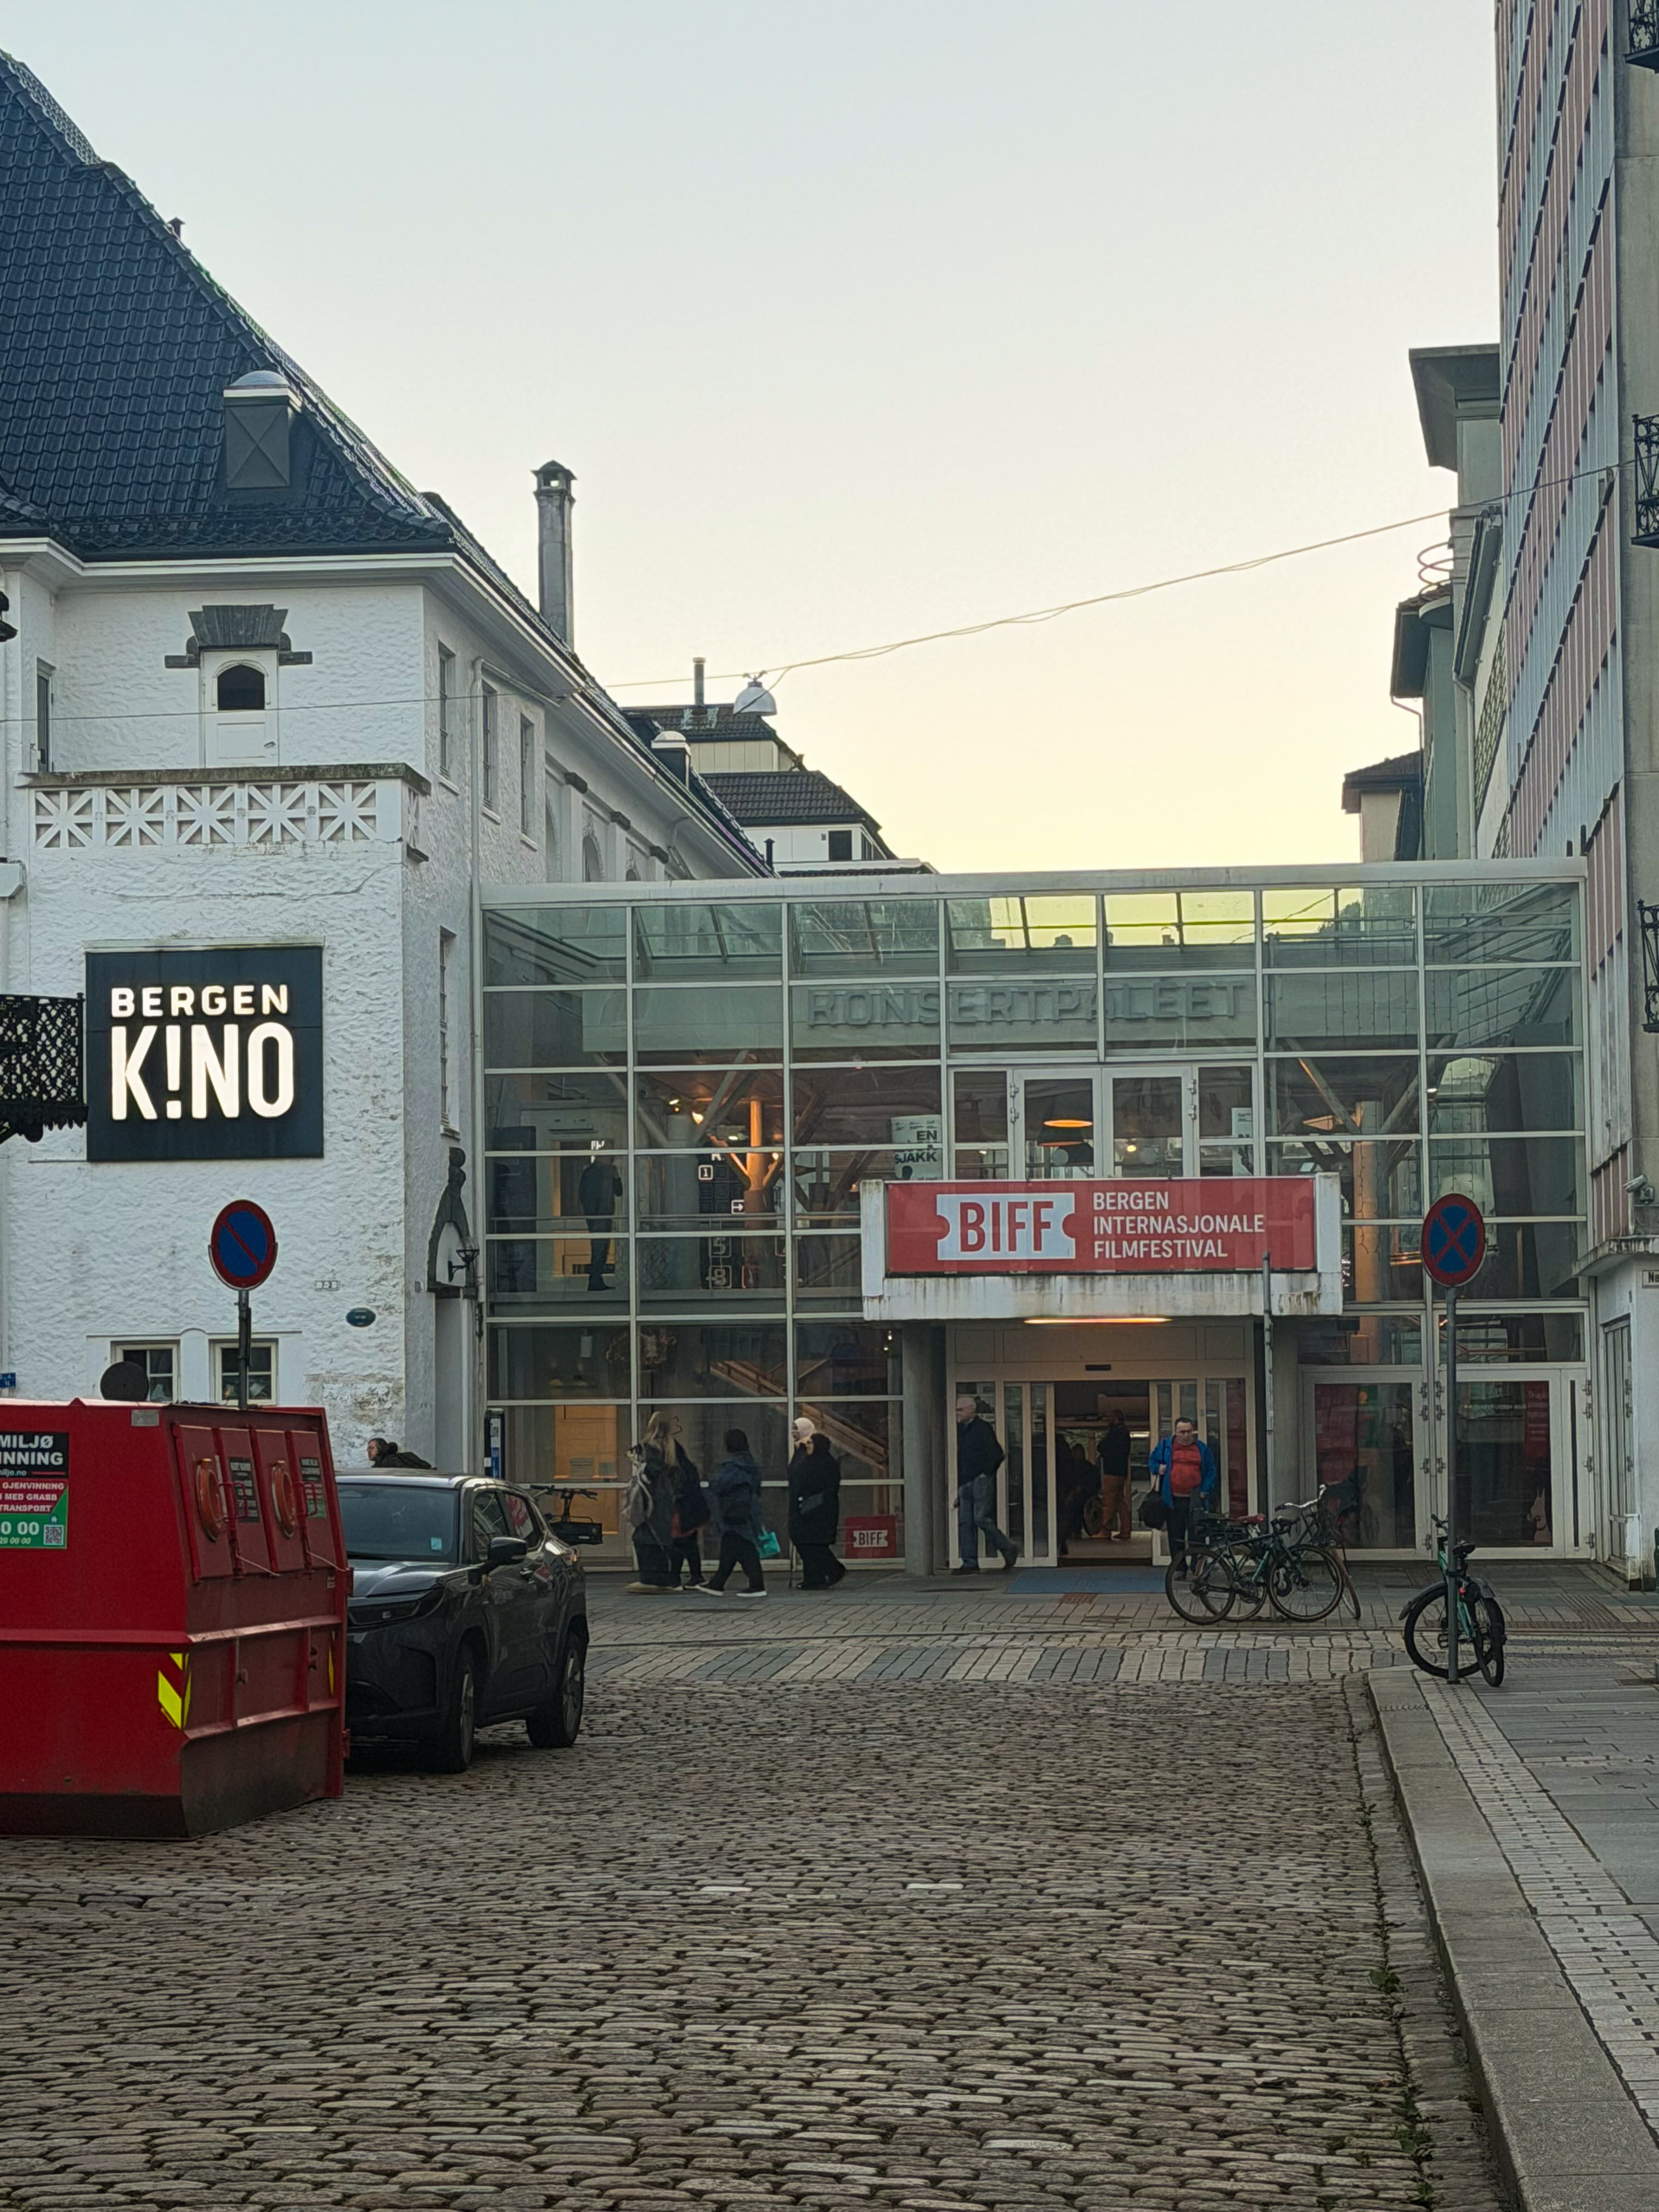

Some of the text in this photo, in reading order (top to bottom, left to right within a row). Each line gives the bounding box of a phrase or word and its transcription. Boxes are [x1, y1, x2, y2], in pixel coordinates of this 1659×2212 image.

[111, 985, 287, 1017] BERGEN
[111, 1022, 294, 1120] K!NO
[917, 1130, 937, 1141] EN
[895, 1152, 937, 1164] SJAKK
[703, 1168, 709, 1177] 1
[1093, 1192, 1169, 1210] BERGEN
[960, 1201, 1054, 1252] BIFF
[1094, 1215, 1265, 1235] INTERNASJONALE
[1094, 1239, 1228, 1259] FILMFESTIVAL
[18, 1521, 40, 1535] 00
[859, 1532, 883, 1545] BIFF
